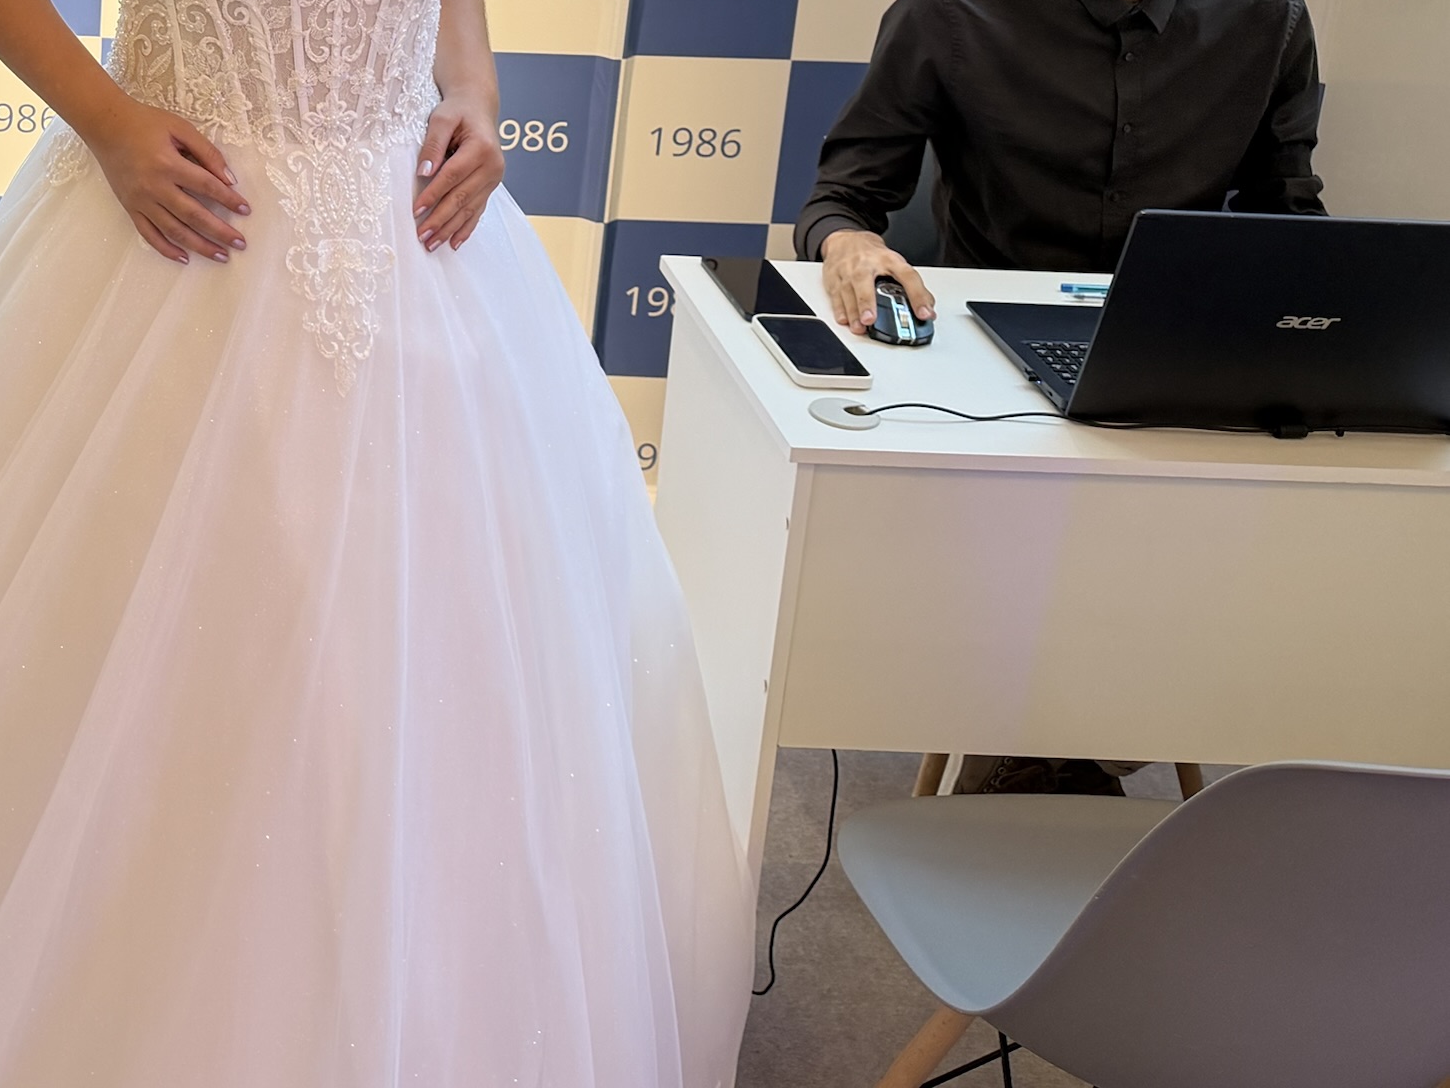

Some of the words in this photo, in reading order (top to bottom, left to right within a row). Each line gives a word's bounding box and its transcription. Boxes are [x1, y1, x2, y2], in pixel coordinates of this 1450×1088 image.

[499, 119, 569, 153] 986
[650, 126, 742, 159] 1986
[625, 286, 678, 318] 19
[1276, 315, 1342, 330] acer
